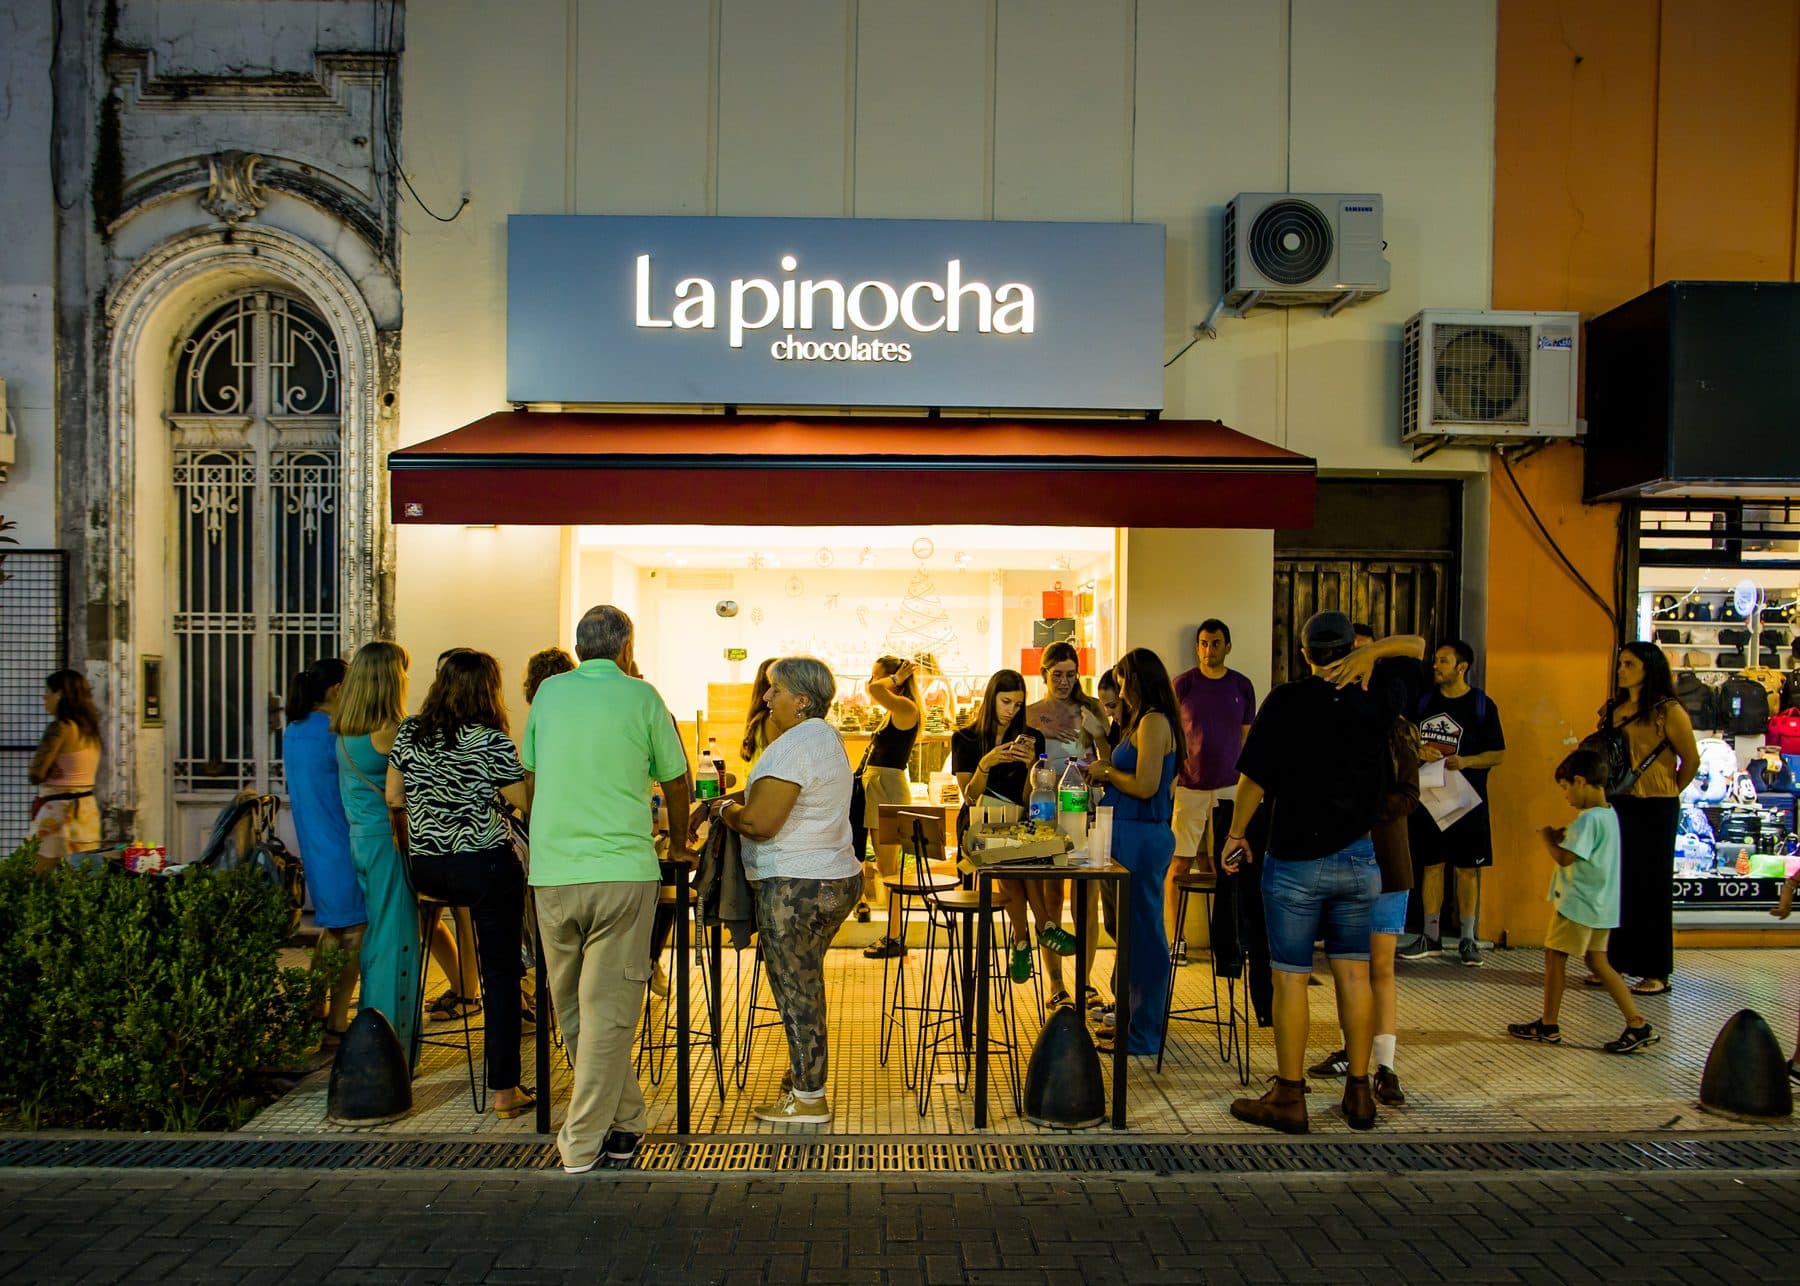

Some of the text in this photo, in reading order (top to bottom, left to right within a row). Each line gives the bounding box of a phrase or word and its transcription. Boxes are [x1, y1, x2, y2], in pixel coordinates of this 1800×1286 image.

[635, 254, 1035, 348] La pinocha
[771, 334, 912, 362] chocolates
[1421, 732, 1457, 743] CALIFORNIA
[1672, 882, 1703, 896] OP 3
[1717, 882, 1749, 896] TOP
[1751, 882, 1760, 896] 3
